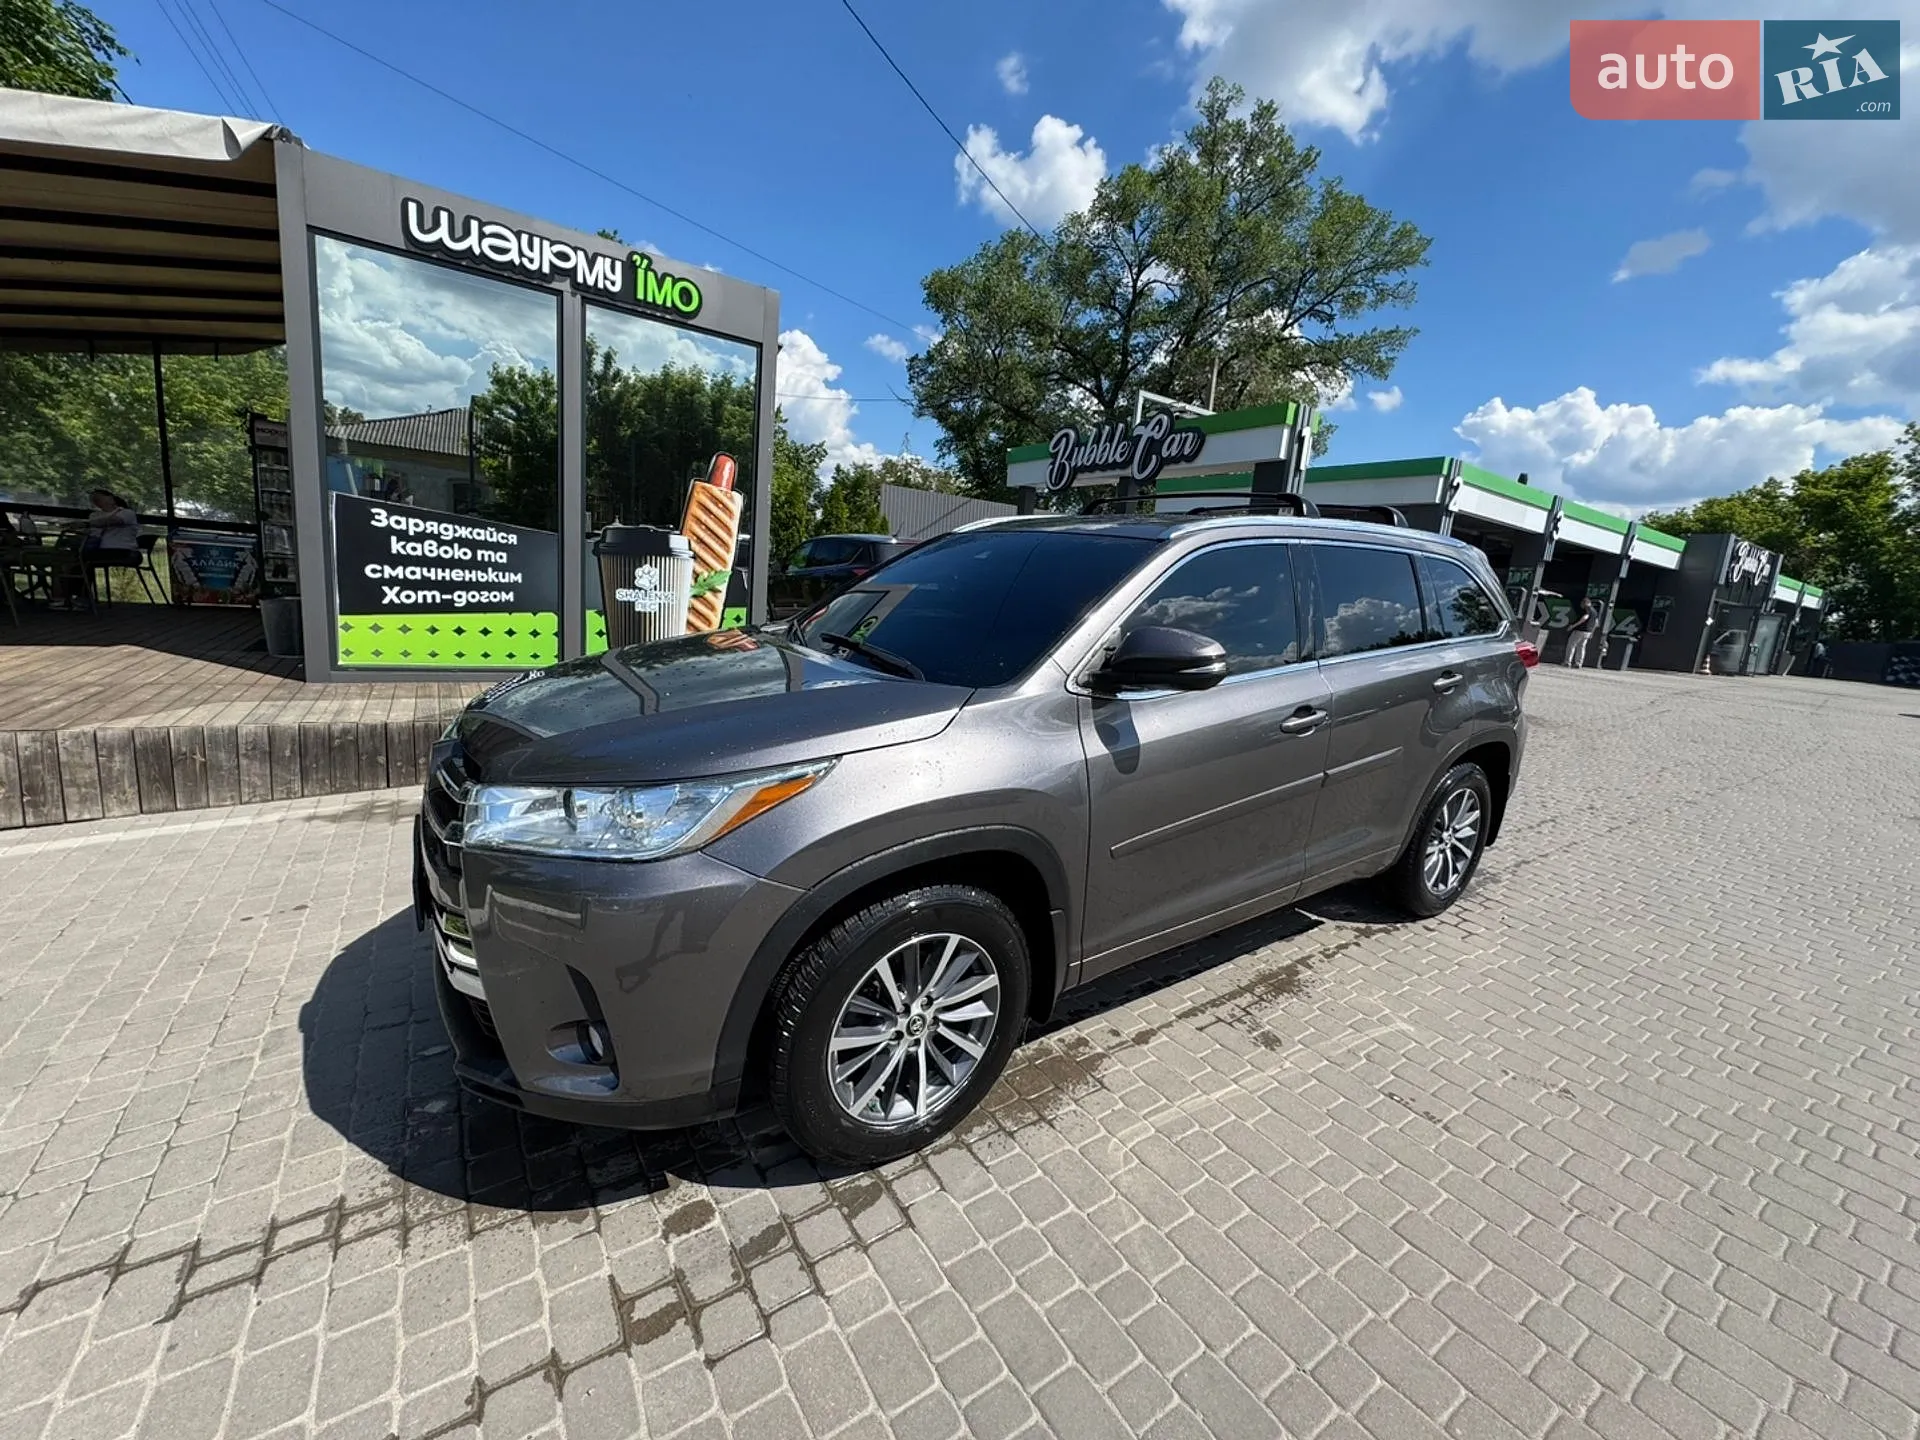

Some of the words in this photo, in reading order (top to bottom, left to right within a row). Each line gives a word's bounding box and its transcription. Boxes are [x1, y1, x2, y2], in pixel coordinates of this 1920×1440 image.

[1046, 422, 1130, 490] Bubble
[1131, 413, 1200, 480] Car
[370, 507, 518, 545] Заряджайся
[390, 535, 473, 560] кавою
[476, 547, 508, 563] та
[364, 563, 522, 584] смачненьким
[381, 585, 515, 607] Хот-догом
